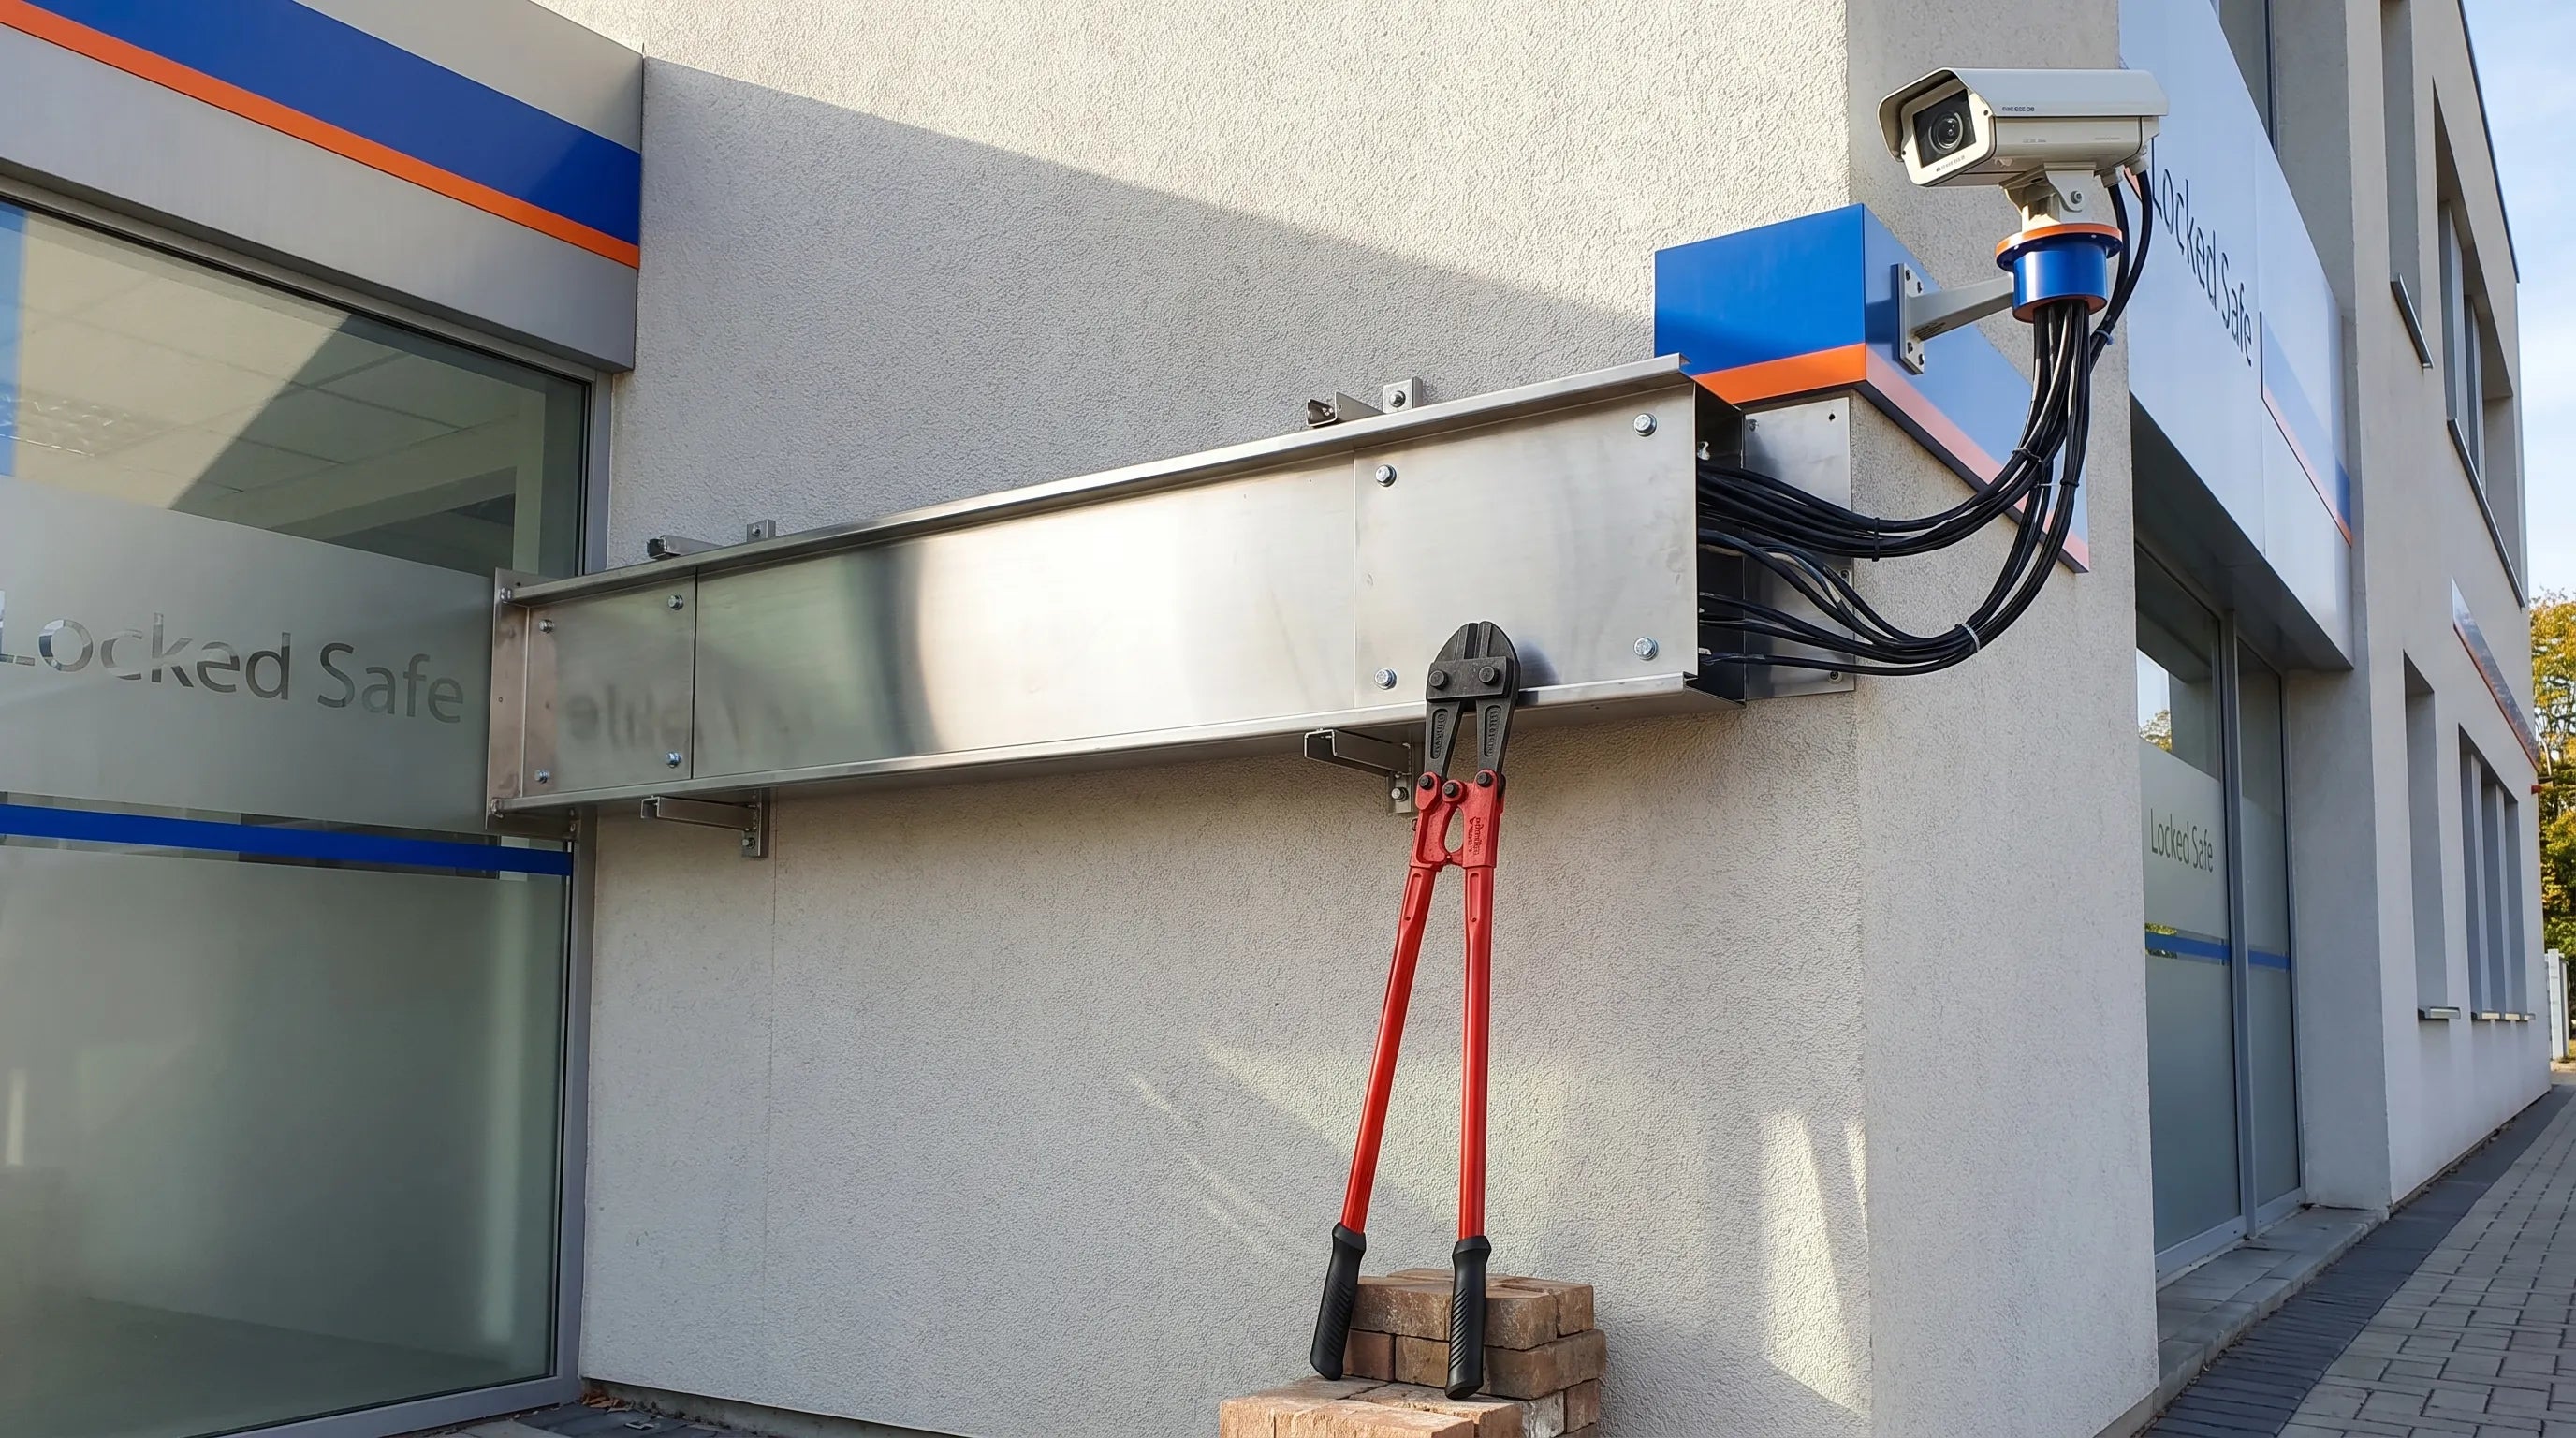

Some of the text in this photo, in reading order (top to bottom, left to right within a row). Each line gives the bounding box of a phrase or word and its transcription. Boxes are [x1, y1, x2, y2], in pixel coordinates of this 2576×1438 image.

[2150, 138, 2252, 367] Locked Safe
[316, 641, 464, 724] Safe
[2150, 808, 2214, 873] Locked Safe
